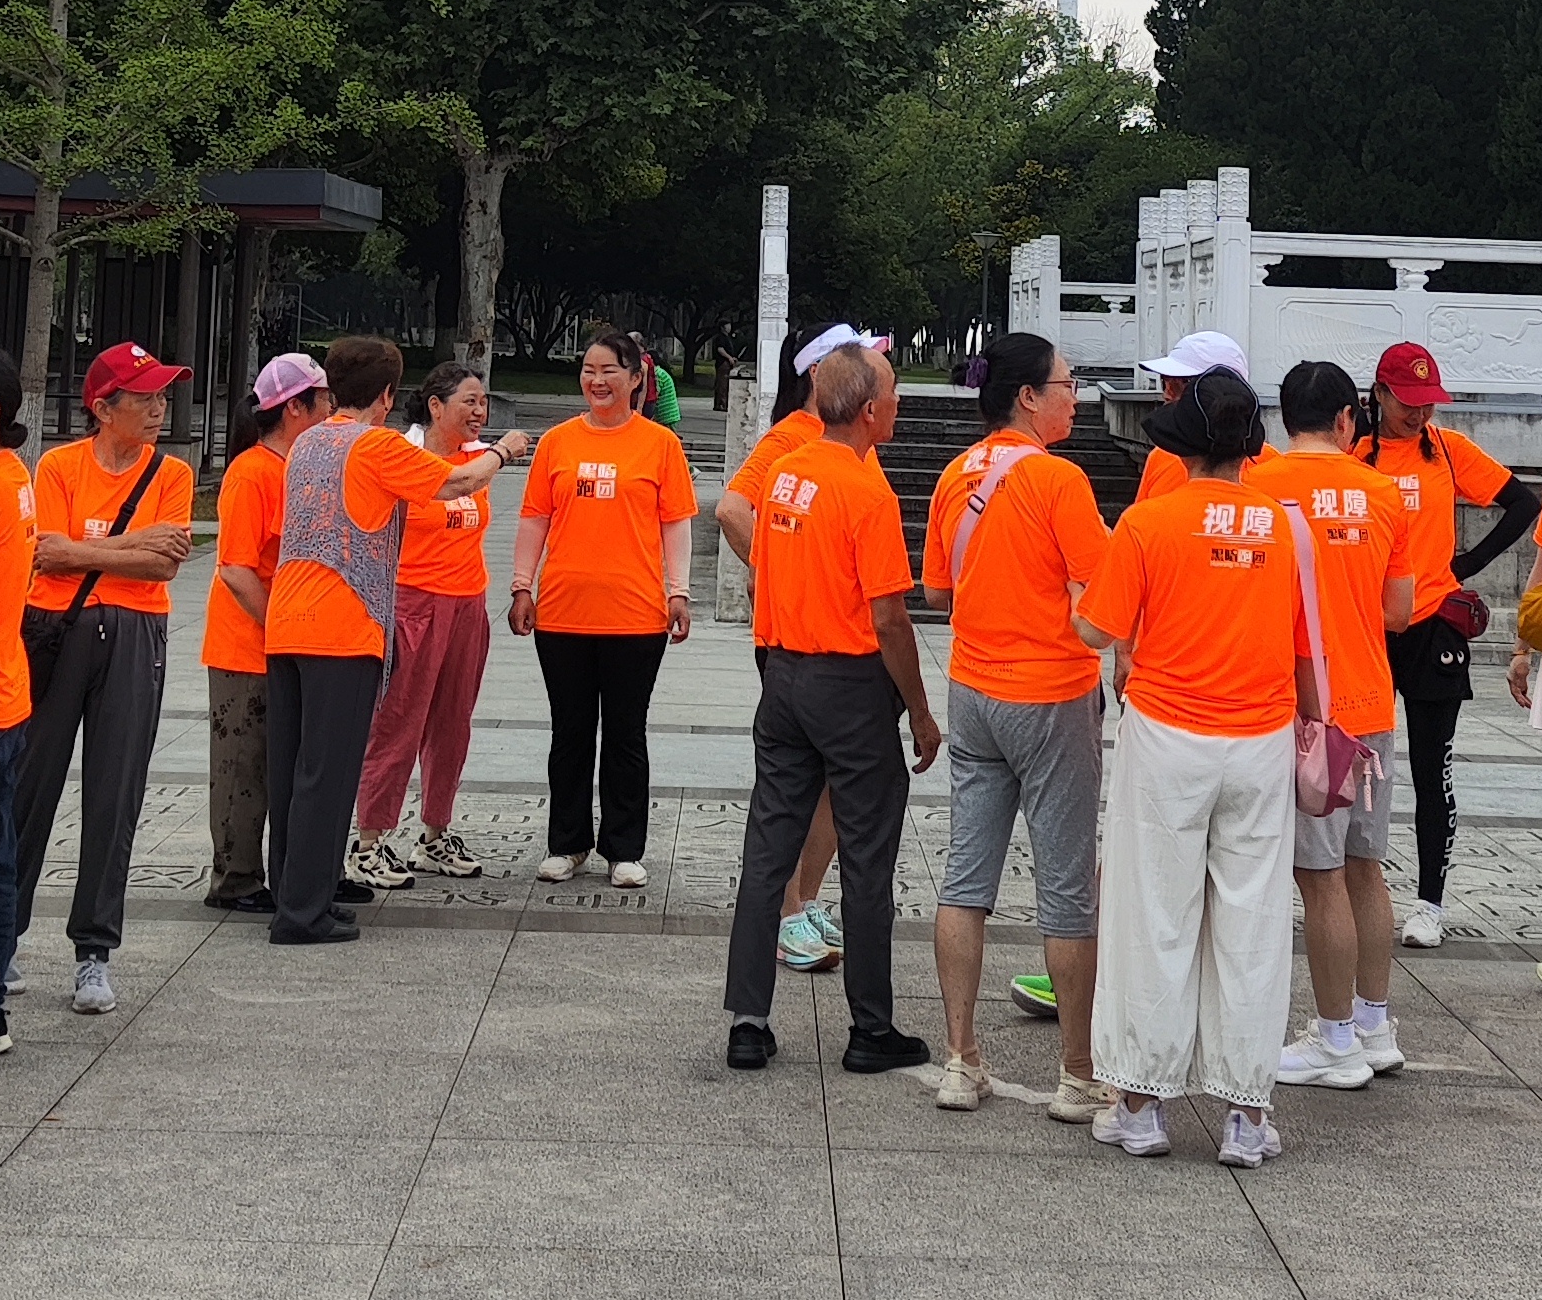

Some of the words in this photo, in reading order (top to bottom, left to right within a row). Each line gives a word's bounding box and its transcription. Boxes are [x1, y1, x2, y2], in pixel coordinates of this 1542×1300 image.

[576, 462, 617, 479] 黑暗
[576, 479, 615, 499] 跑团
[771, 472, 819, 510] 陪跑
[1311, 488, 1368, 518] 视障
[83, 518, 114, 540] 黑
[446, 510, 480, 529] 跑团
[1202, 502, 1274, 538] 视障
